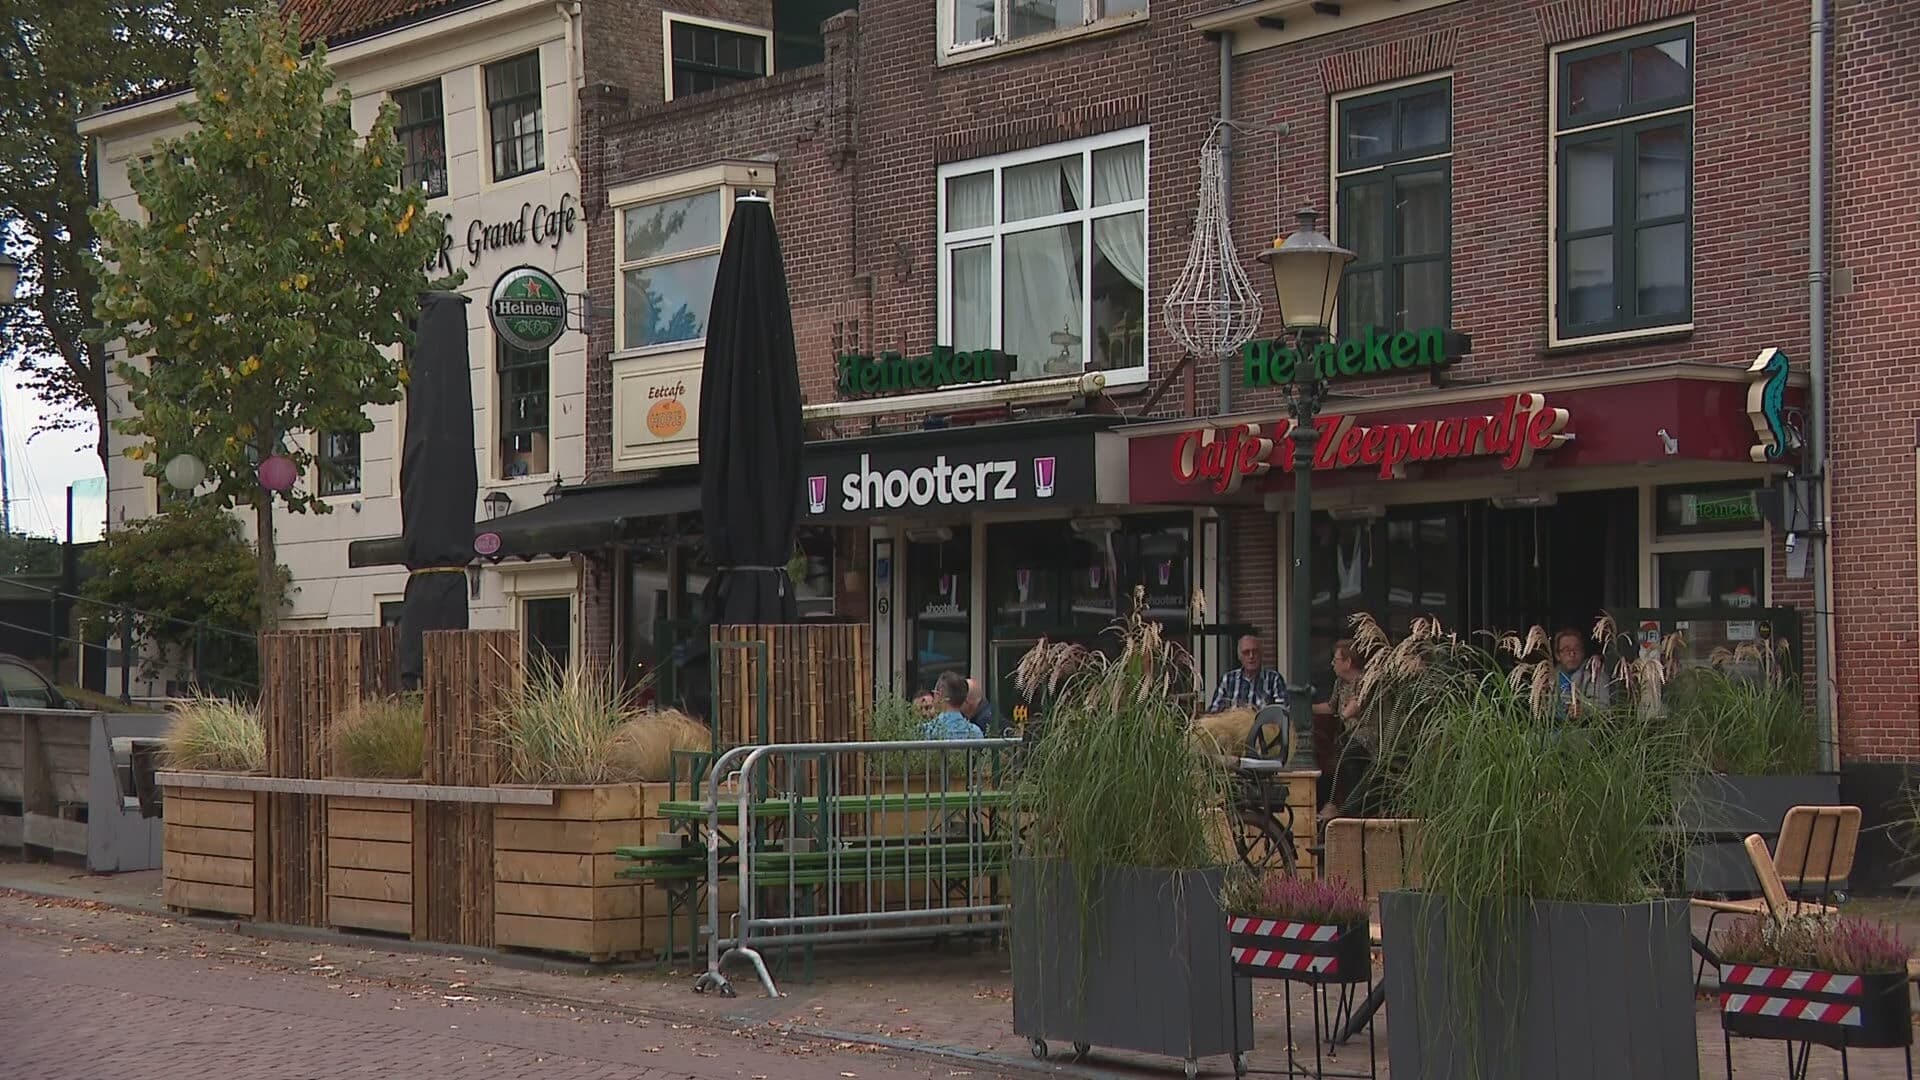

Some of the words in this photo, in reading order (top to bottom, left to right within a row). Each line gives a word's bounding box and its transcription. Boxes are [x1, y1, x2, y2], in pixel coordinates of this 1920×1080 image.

[467, 202, 531, 266] Grand
[499, 301, 562, 316] Heineken
[839, 346, 995, 395] Heineken
[1243, 325, 1446, 388] Heneken
[648, 380, 685, 403] Eetcafe
[1311, 393, 1558, 479] Zeepaardje
[842, 453, 1017, 511] shooterz
